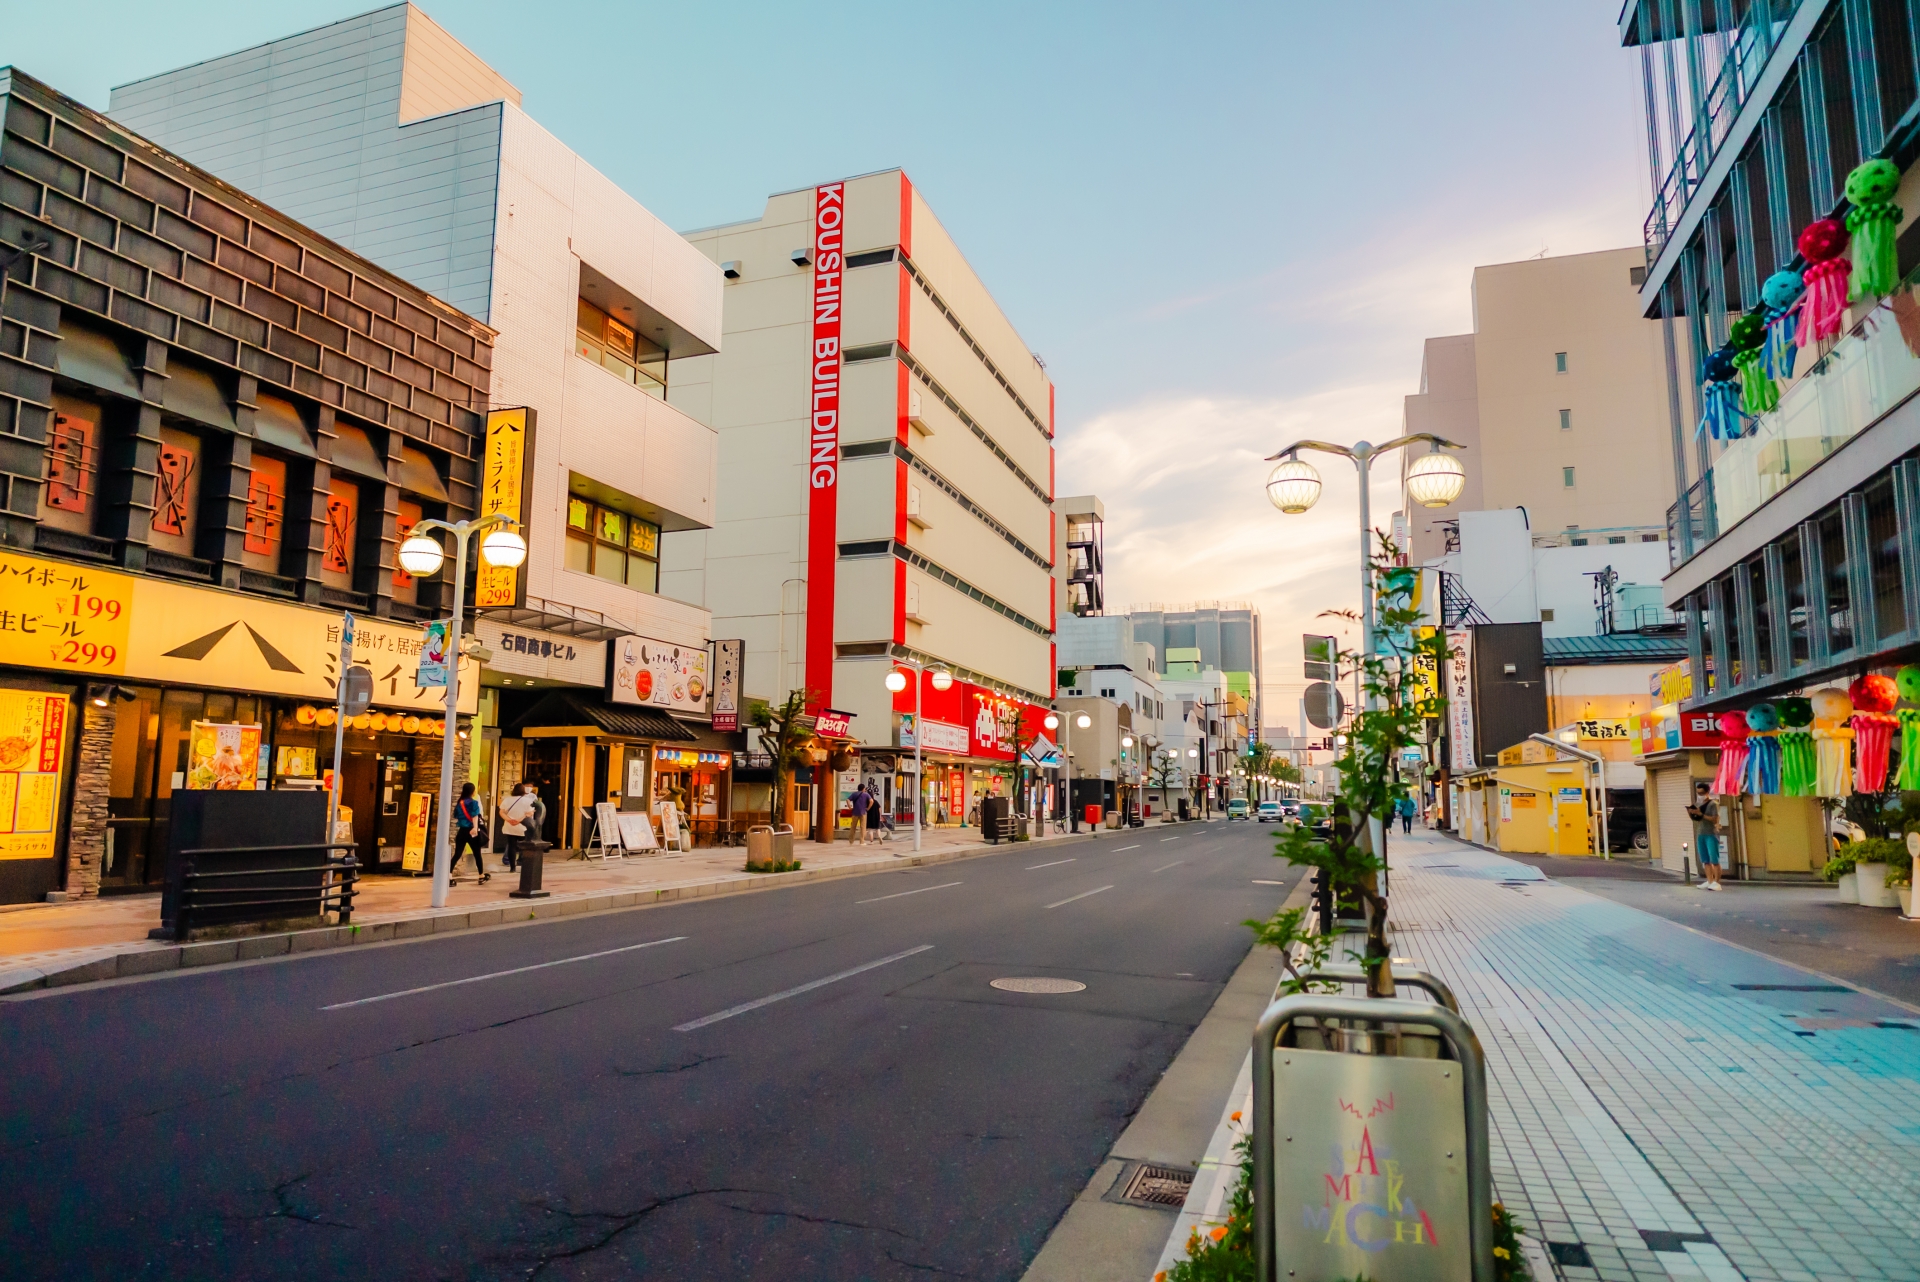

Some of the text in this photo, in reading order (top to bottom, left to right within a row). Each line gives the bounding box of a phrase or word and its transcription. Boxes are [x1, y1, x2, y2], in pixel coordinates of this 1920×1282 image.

[811, 184, 842, 489] KOUSHIN BUILDING
[0, 564, 91, 592] ハイボール
[481, 576, 511, 589] 生ビール
[0, 610, 85, 638] 生ビール
[501, 632, 577, 661] 石岡商事ビル
[9, 843, 47, 852] ミライザカ
